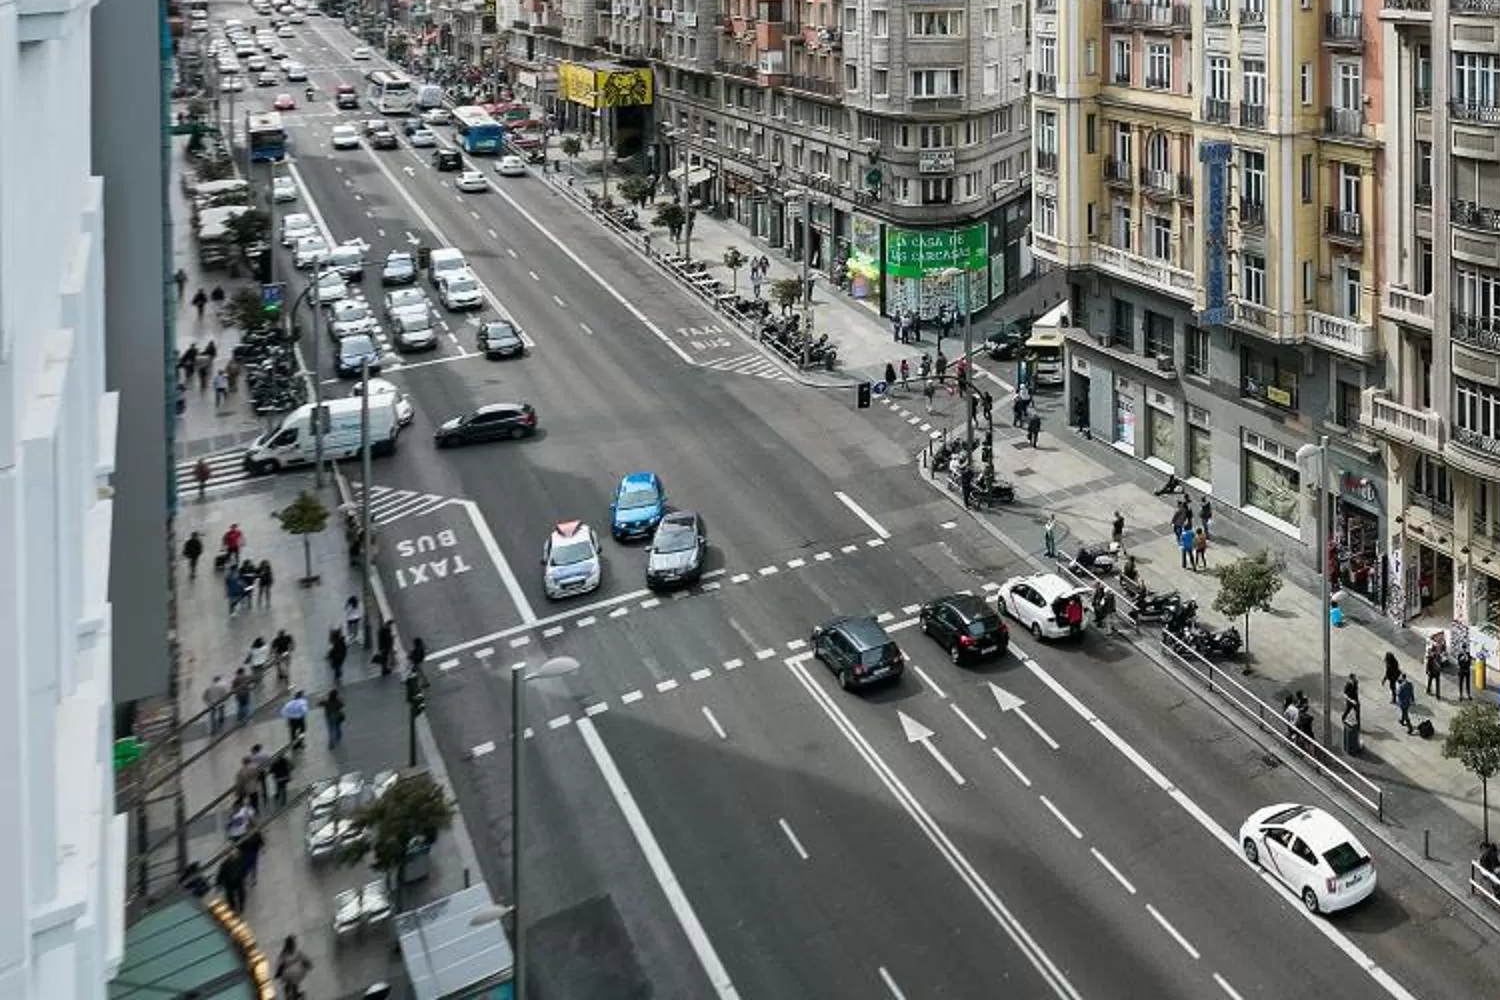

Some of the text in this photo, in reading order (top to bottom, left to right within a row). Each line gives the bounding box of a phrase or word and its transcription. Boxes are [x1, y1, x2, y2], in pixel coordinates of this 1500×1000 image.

[911, 237, 943, 248] CASA
[396, 529, 457, 557] BUS
[396, 555, 472, 589] TAXI
